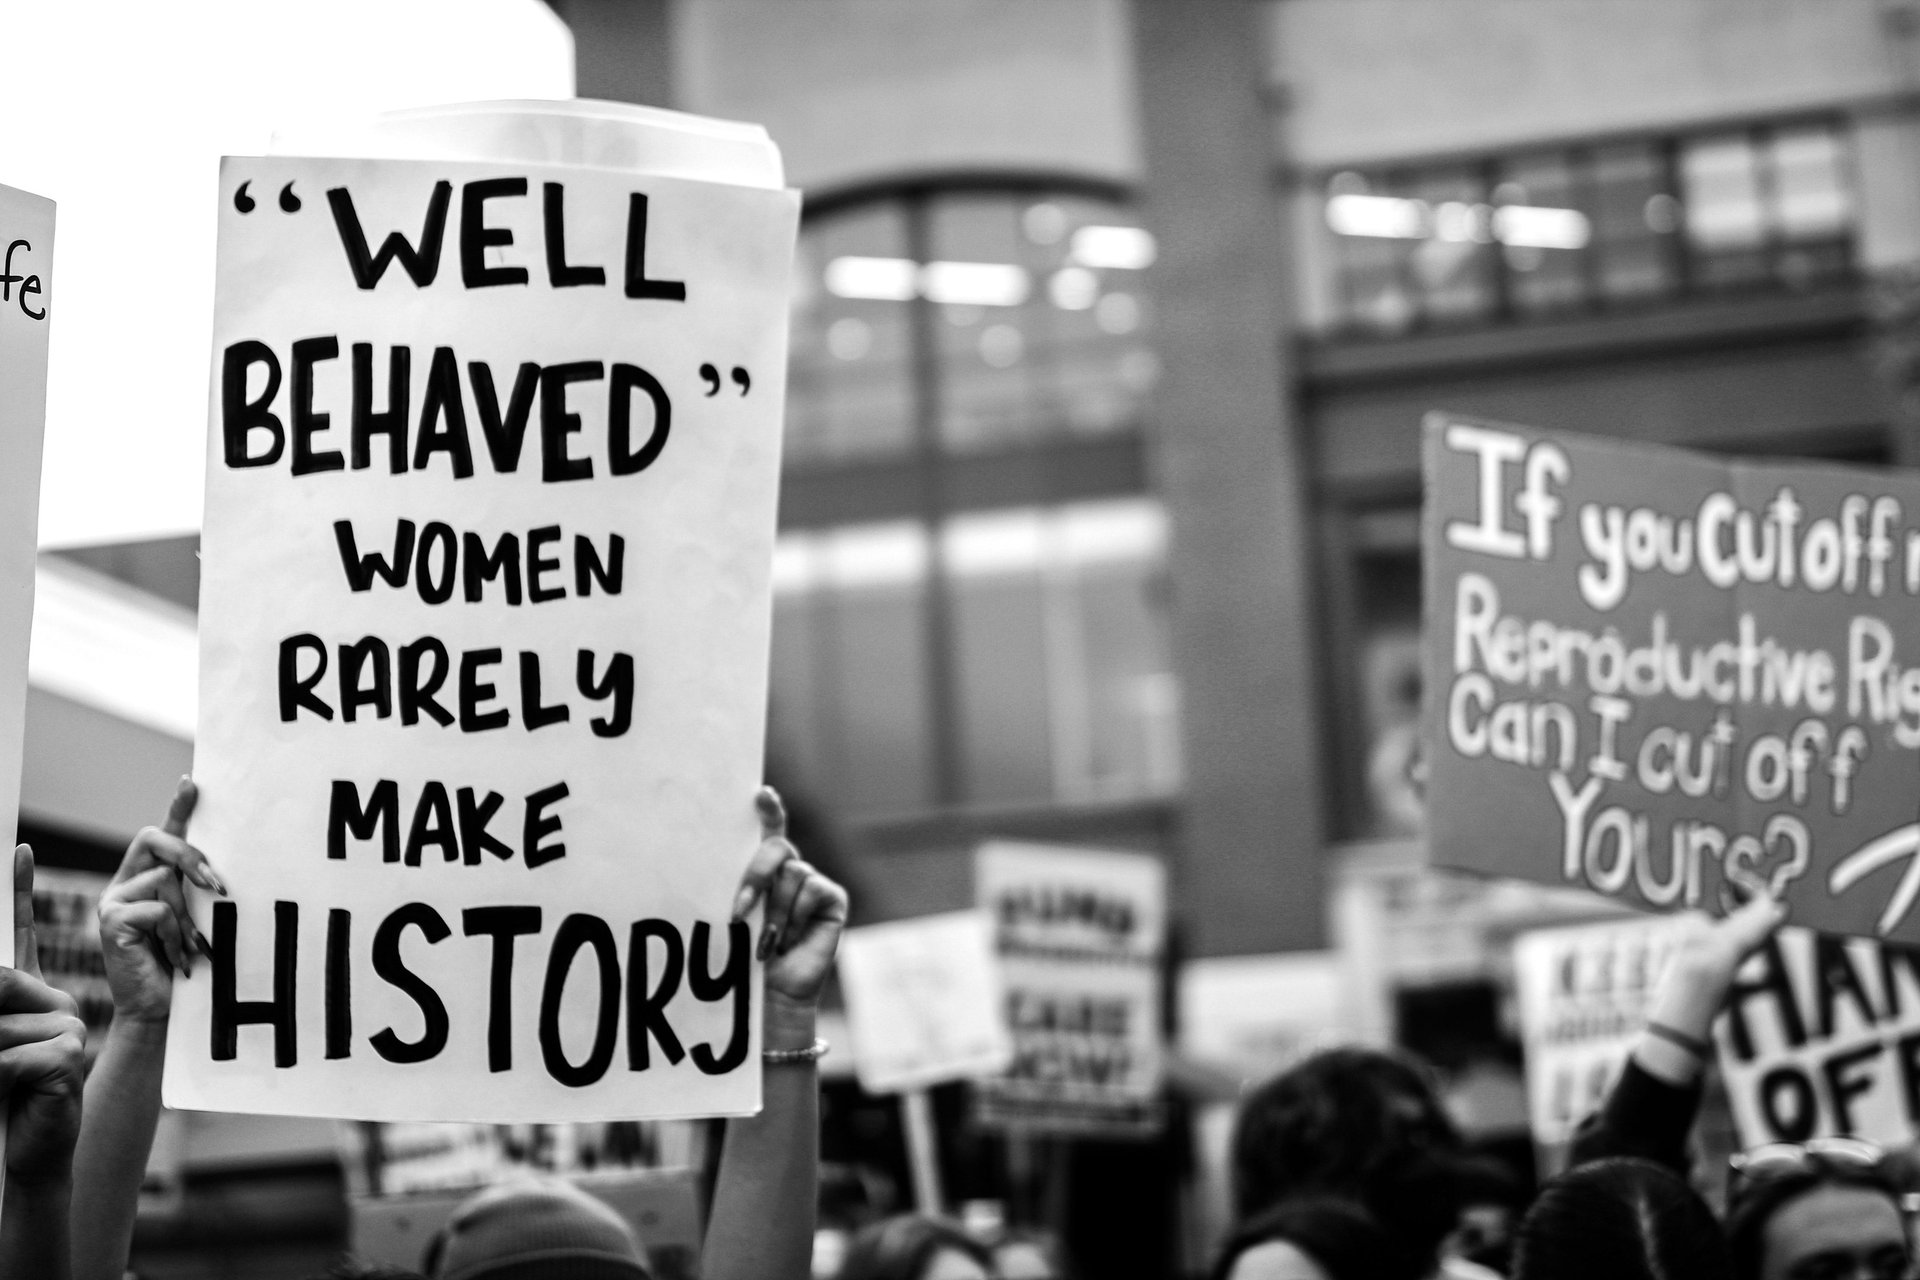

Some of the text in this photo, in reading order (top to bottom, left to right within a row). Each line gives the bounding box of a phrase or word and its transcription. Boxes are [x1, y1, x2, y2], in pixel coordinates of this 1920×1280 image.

[333, 518, 625, 607] WOMEN
[1445, 424, 1570, 560] If
[1579, 502, 1693, 610] you
[1802, 494, 1901, 597] off
[278, 633, 635, 739] RARELY
[1453, 572, 1836, 713] Reproductive
[1448, 671, 1868, 815] Can I cut off
[327, 779, 570, 870] MAKE
[1548, 770, 1810, 908] Yours?
[210, 900, 751, 1088] HISTORY
